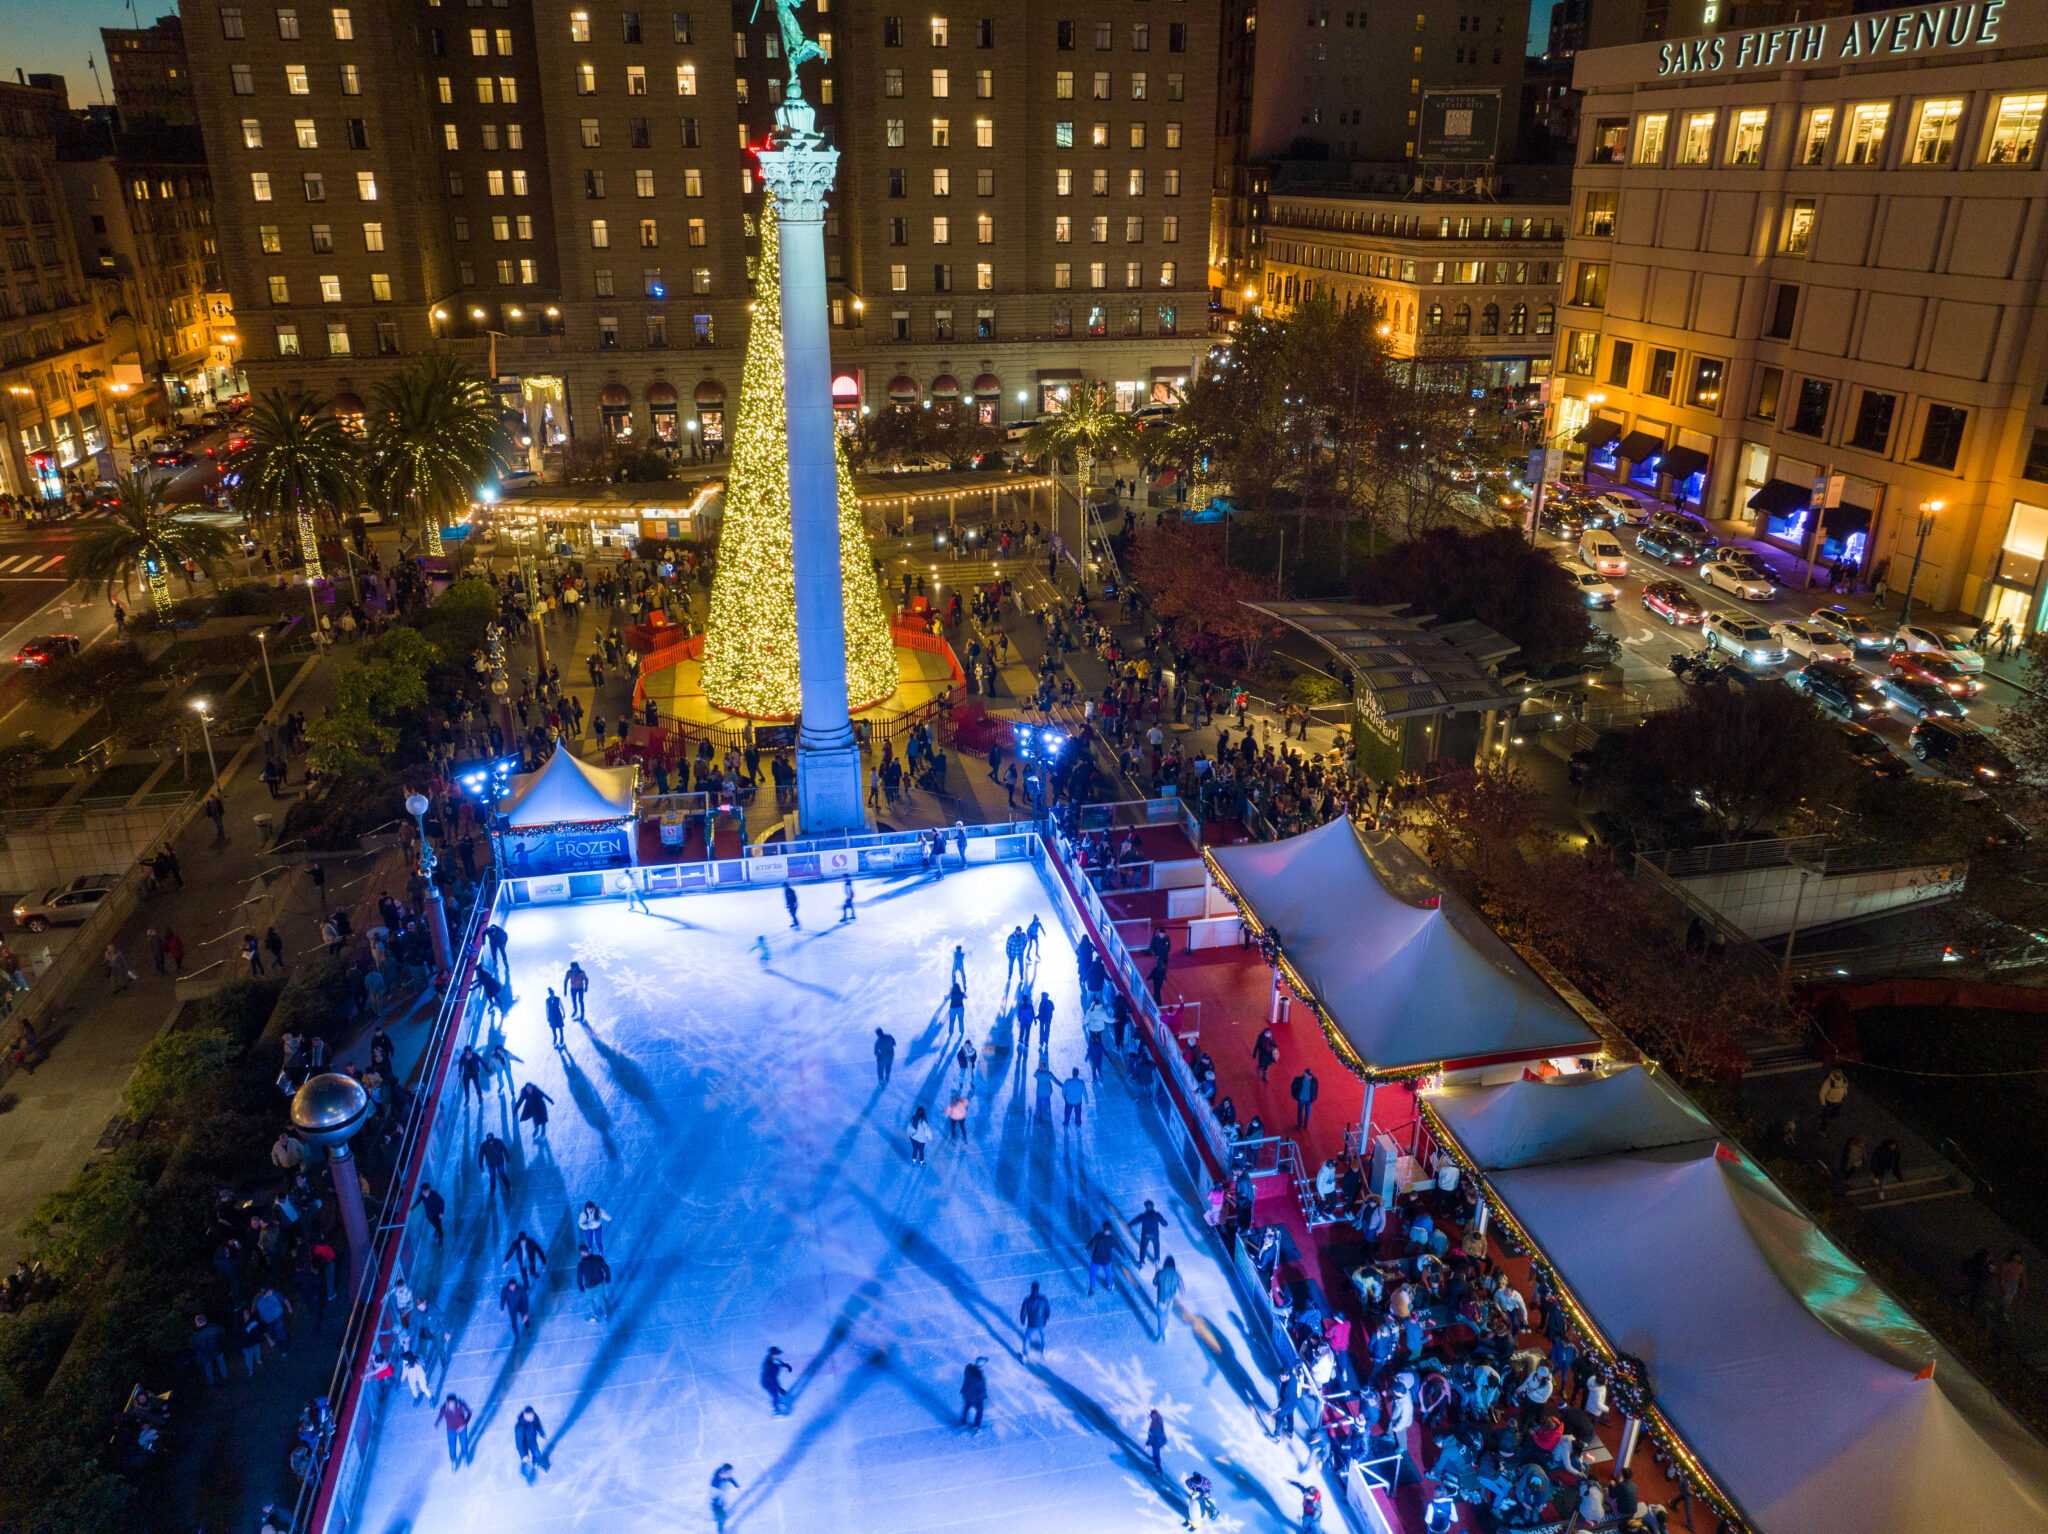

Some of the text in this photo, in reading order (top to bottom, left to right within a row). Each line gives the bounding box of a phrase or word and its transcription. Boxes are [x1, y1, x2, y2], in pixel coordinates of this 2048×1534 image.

[1658, 0, 2006, 77] SAKS FIFTH AVENUE
[555, 838, 622, 859] FROZEN
